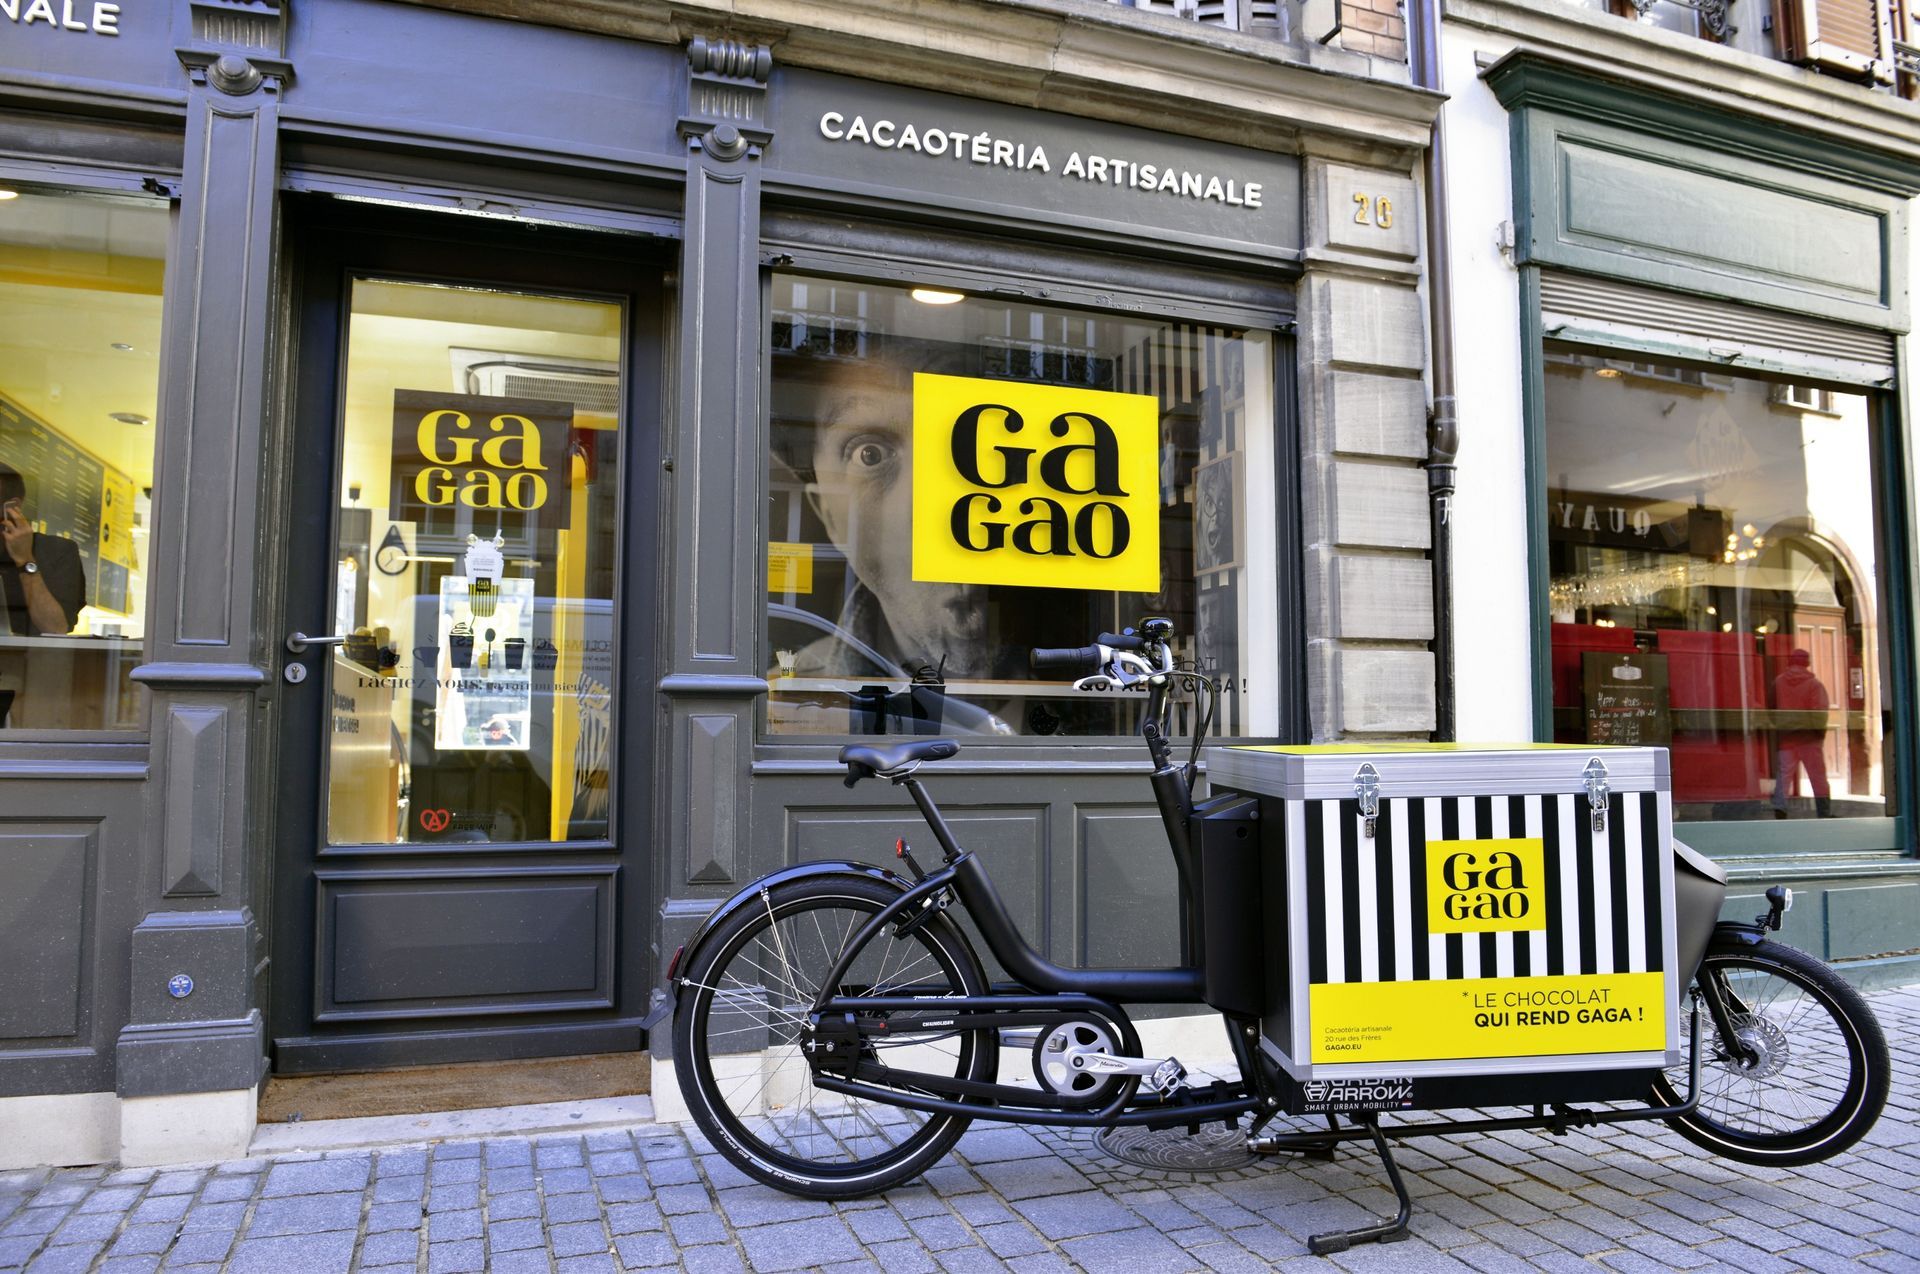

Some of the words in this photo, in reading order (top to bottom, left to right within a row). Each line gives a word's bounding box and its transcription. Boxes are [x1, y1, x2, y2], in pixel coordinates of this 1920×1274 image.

[820, 111, 1050, 172] CACAOTÉRIA
[1063, 151, 1263, 208] ARTISANALE
[1353, 192, 1393, 230] 20
[417, 410, 548, 470] Ga
[951, 404, 1130, 497] Ga
[415, 466, 548, 510] Gao
[951, 493, 1130, 559] Gao
[1443, 851, 1528, 891] Ga
[1444, 891, 1529, 920] Gao
[1474, 992, 1497, 1008] LE
[1503, 988, 1611, 1007] CHOCOLAT
[1361, 1025, 1393, 1033] artisanale
[1474, 1012, 1509, 1028] QUI
[1517, 1010, 1570, 1026] REND
[1576, 1007, 1632, 1024] GAGA
[1325, 1043, 1362, 1051] GAGAO.EU
[1304, 1103, 1330, 1112] SMART
[1334, 1102, 1359, 1110] URBAN
[1363, 1101, 1399, 1110] MOBILITY
